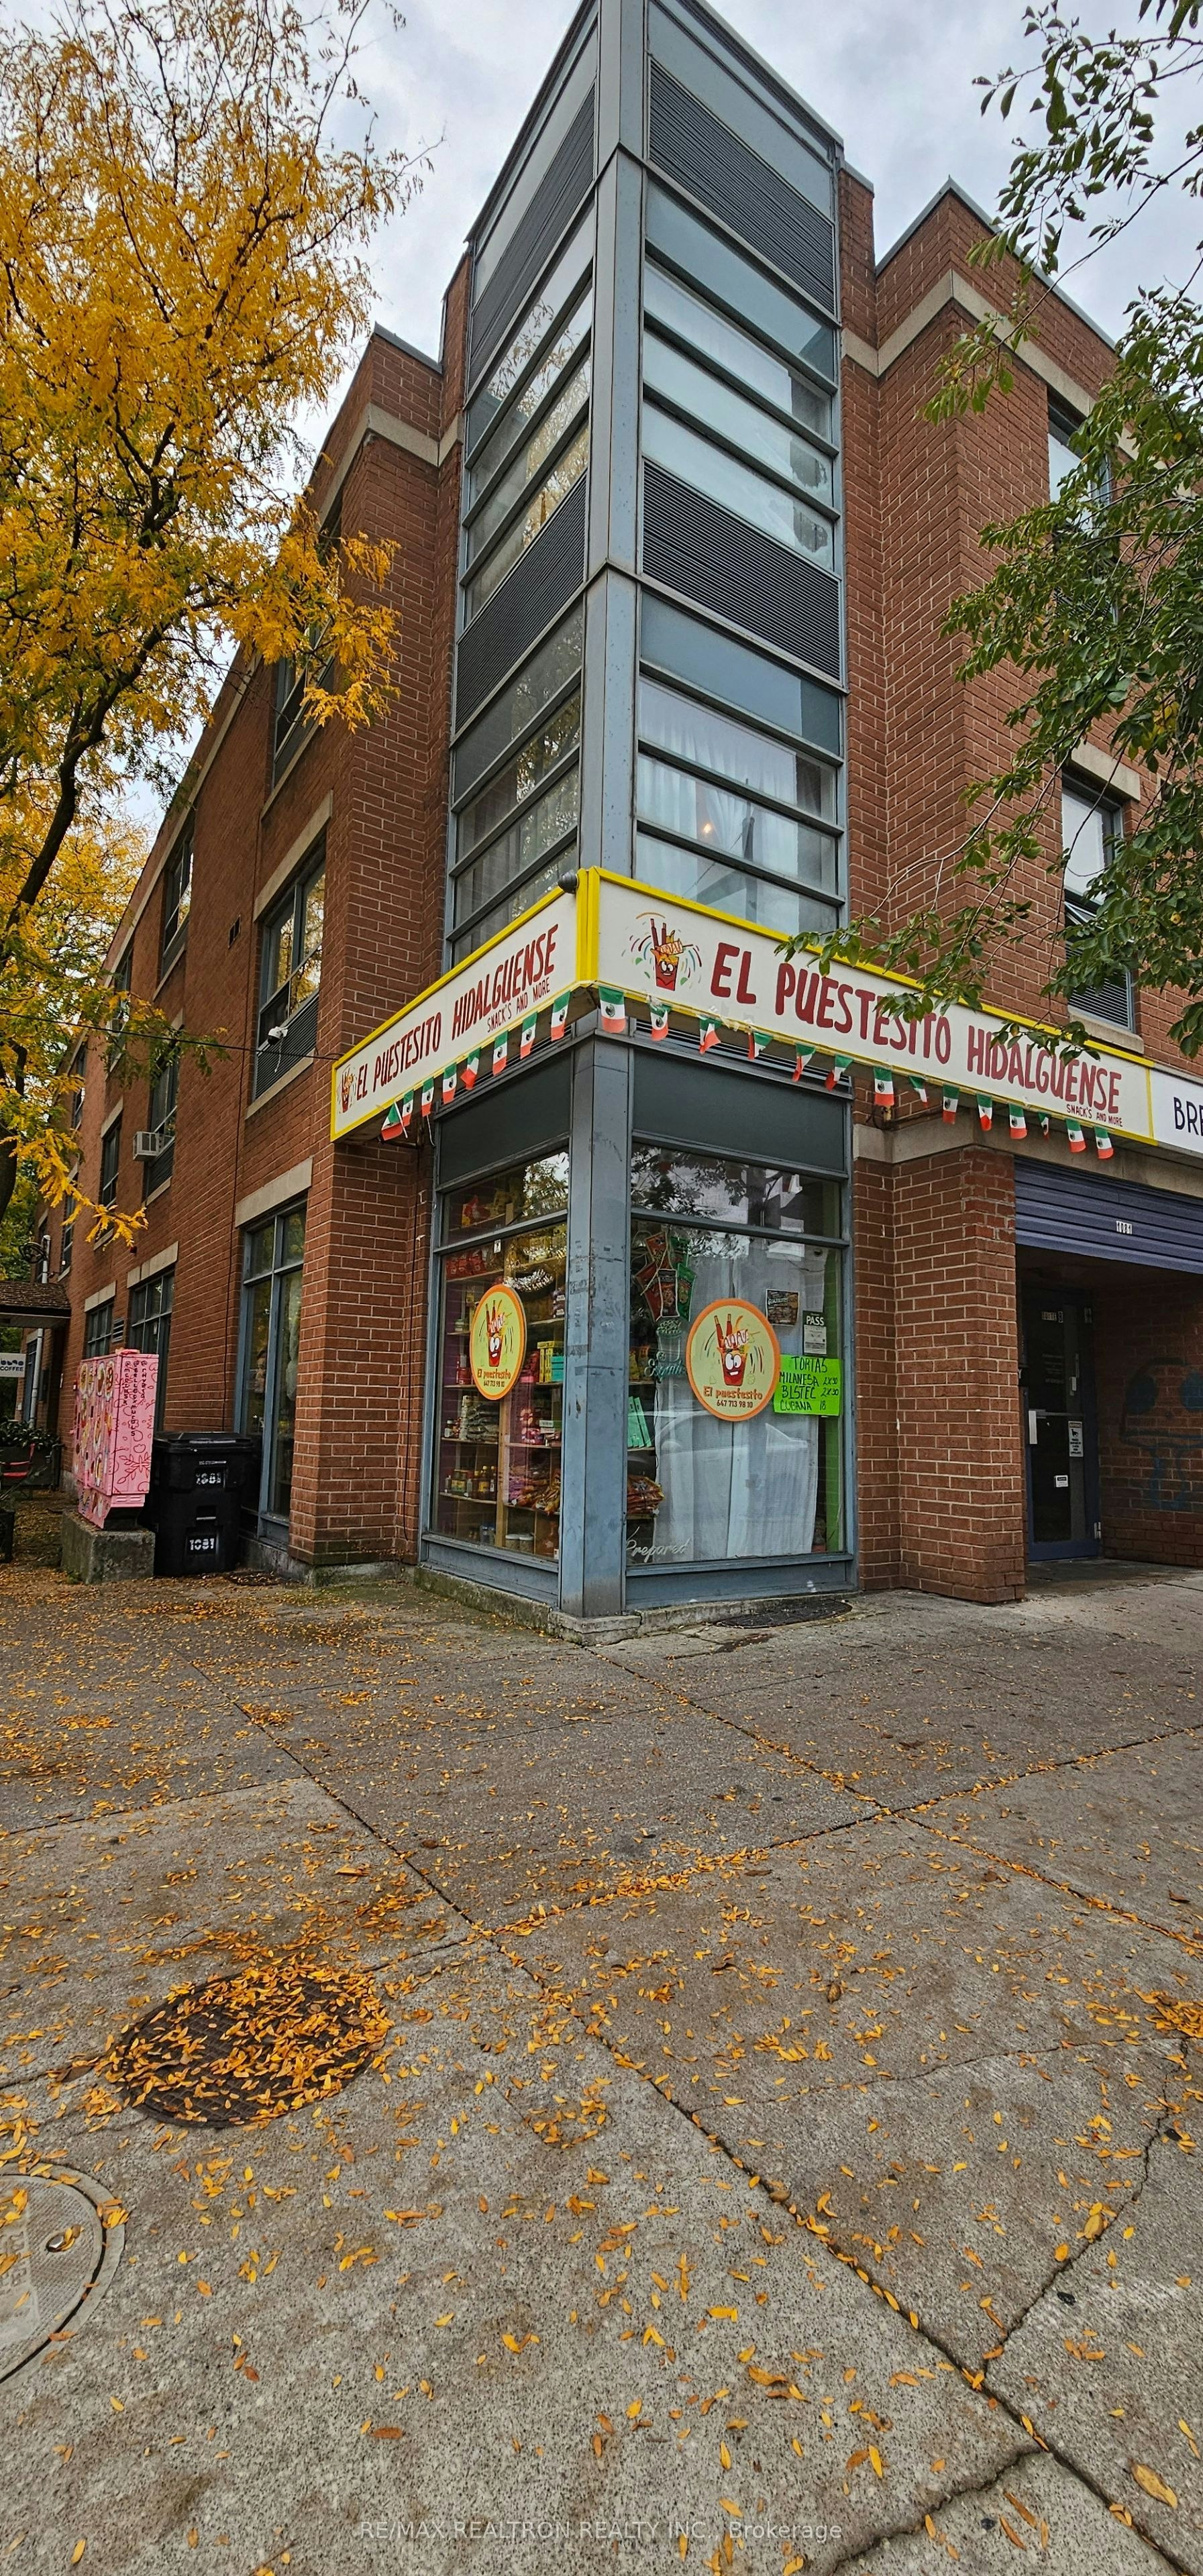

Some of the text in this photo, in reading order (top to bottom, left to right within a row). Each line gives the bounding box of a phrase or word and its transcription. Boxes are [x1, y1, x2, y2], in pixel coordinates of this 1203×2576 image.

[356, 924, 558, 1100] EL PUESTESITO HIDALGUENSE
[487, 977, 550, 1033] SNACK'S AND MORE
[710, 942, 1122, 1114] EL PUESTESITO HIDALGUENSE
[1066, 1104, 1123, 1127] SNACK'S AND MORE
[1116, 1221, 1133, 1235] 1081
[806, 1315, 825, 1326] PASS
[791, 1356, 828, 1373] TORTAS
[779, 1371, 820, 1387] MILANESA
[703, 1385, 764, 1400] El puestesito
[819, 1400, 827, 1411] 18
[189, 1538, 215, 1551] 1081
